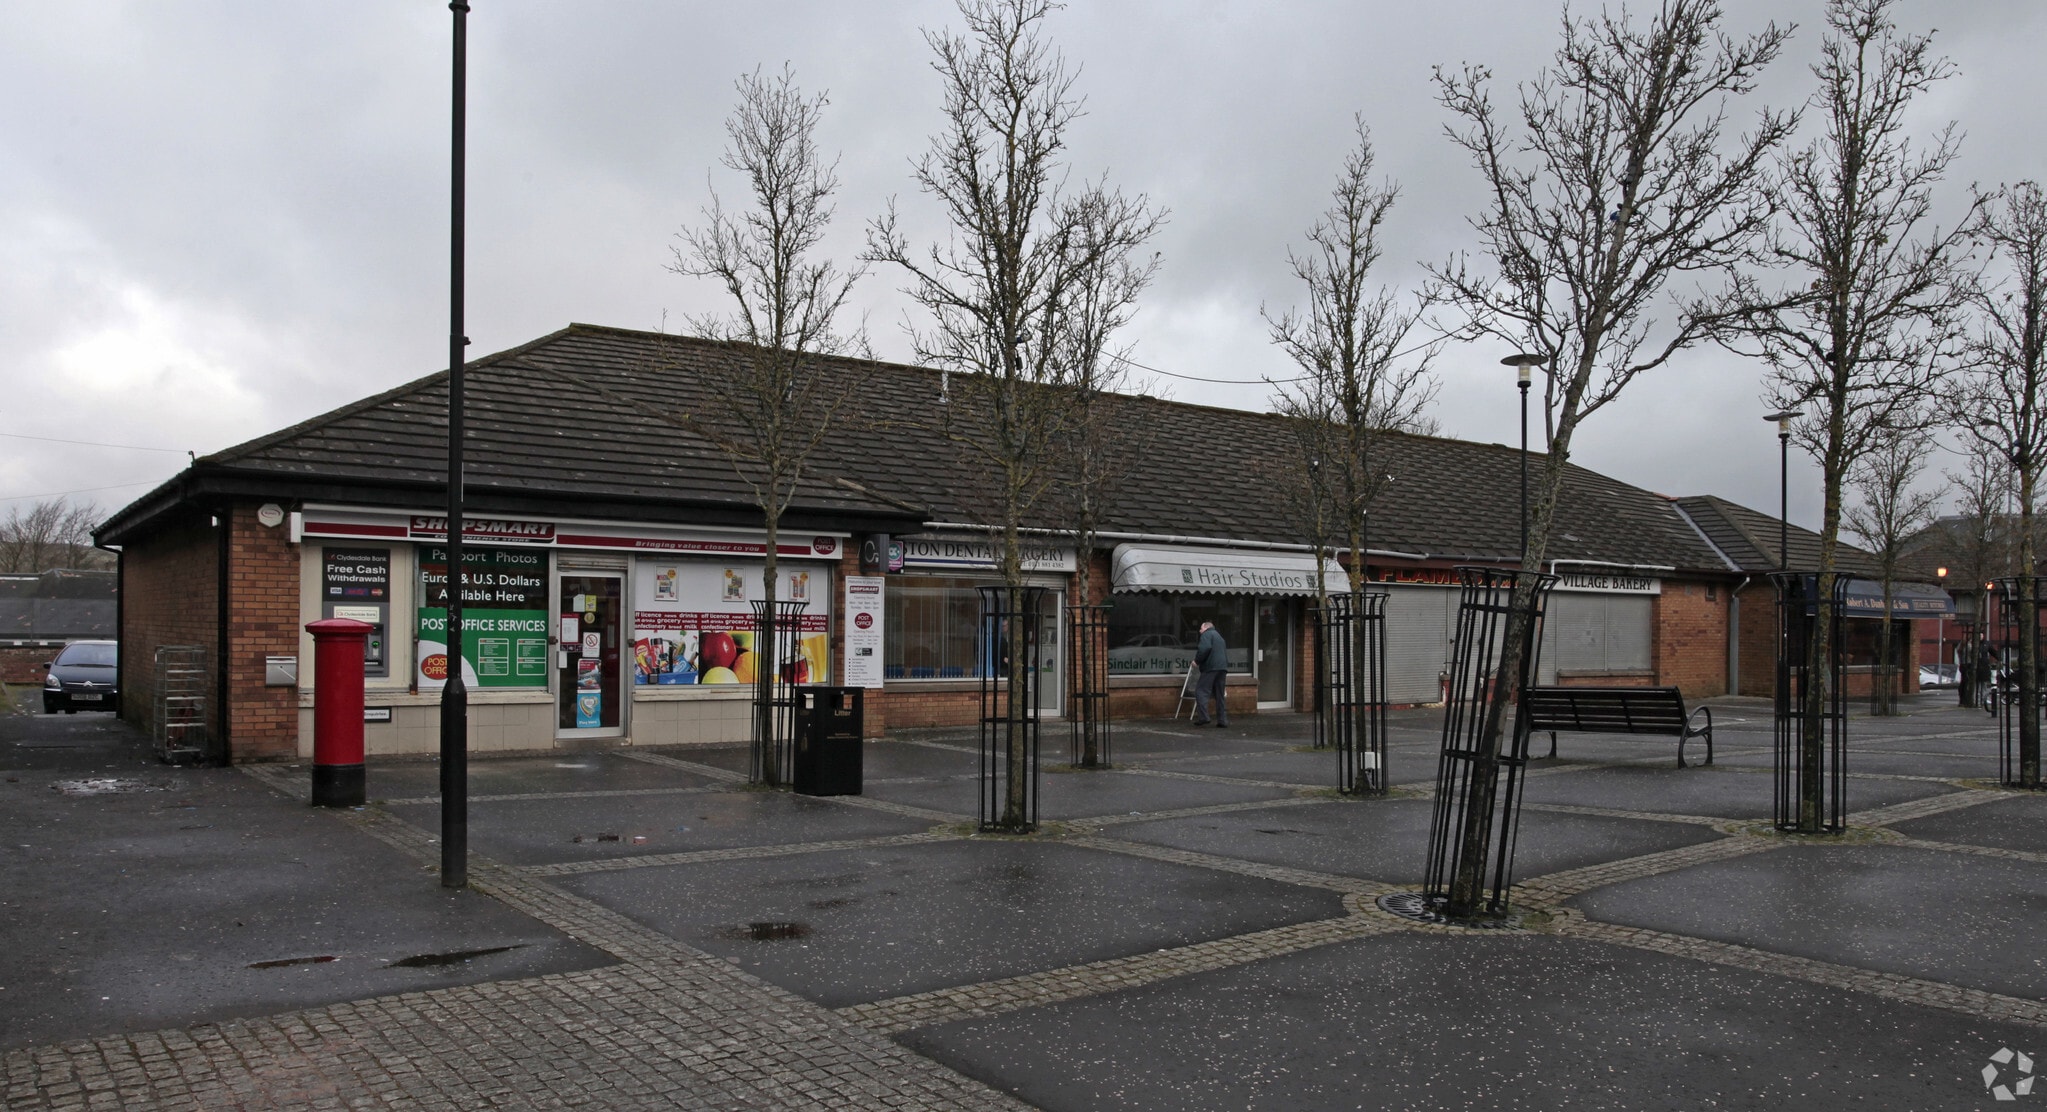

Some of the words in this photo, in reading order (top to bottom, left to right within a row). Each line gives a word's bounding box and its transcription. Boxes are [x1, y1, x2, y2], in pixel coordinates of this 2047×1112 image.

[434, 534, 500, 542] COENIENCE
[635, 540, 675, 549] Bringing
[336, 554, 371, 562] Clydesdale
[432, 549, 487, 562] Paort
[496, 551, 538, 564] Photos
[327, 564, 353, 574] Free
[356, 565, 386, 574] Cash
[327, 574, 386, 583] Withdrawals
[461, 573, 469, 584] &
[473, 574, 496, 585] U.S.
[499, 574, 541, 587] Dollars
[1198, 568, 1234, 586] Hair
[1240, 569, 1302, 588] Studios
[1562, 575, 1608, 589] VILLAGE
[1612, 578, 1652, 590] BAKERY
[438, 589, 492, 600] Ailable
[496, 590, 525, 602] Here
[497, 619, 546, 632] SERVICES
[1108, 656, 1147, 669] Sinclair
[1151, 657, 1172, 669] Hair
[834, 709, 851, 717] Litter
